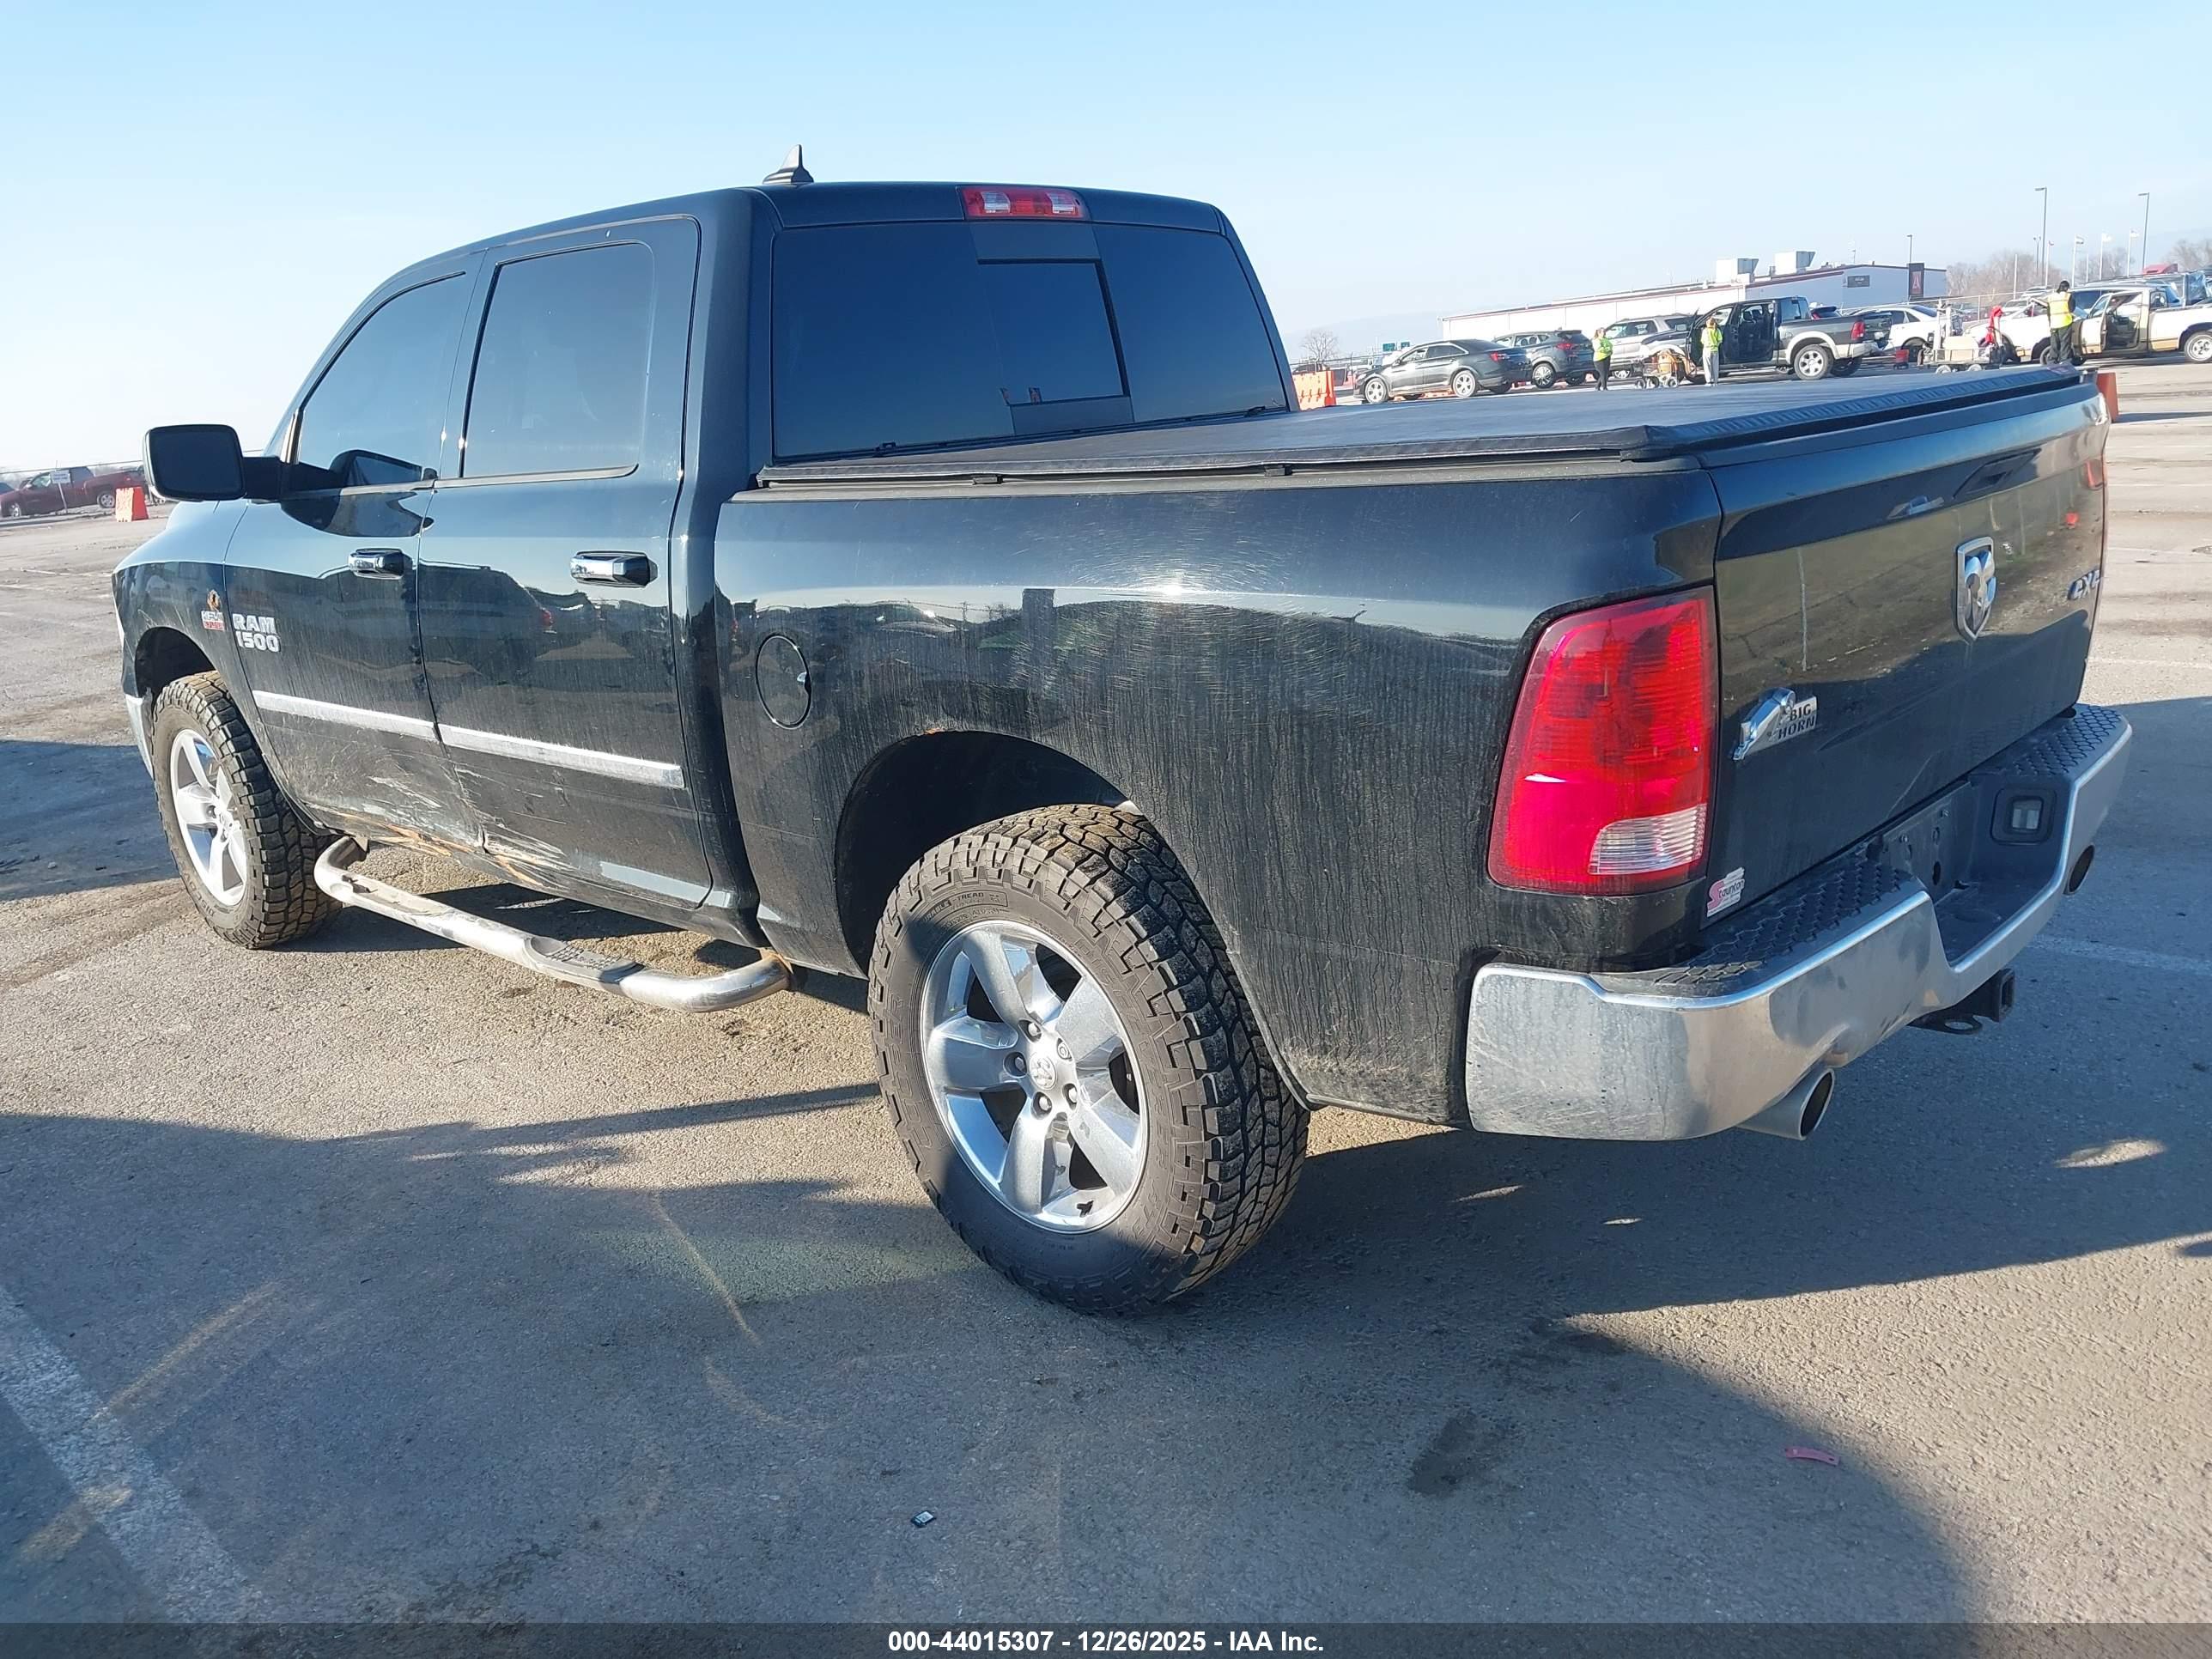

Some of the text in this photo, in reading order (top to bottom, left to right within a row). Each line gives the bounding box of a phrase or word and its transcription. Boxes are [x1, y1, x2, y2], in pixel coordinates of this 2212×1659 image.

[232, 613, 276, 635] RAM
[235, 631, 281, 653] 1500
[1790, 703, 1812, 721] BIG
[1778, 715, 1815, 740] HORN
